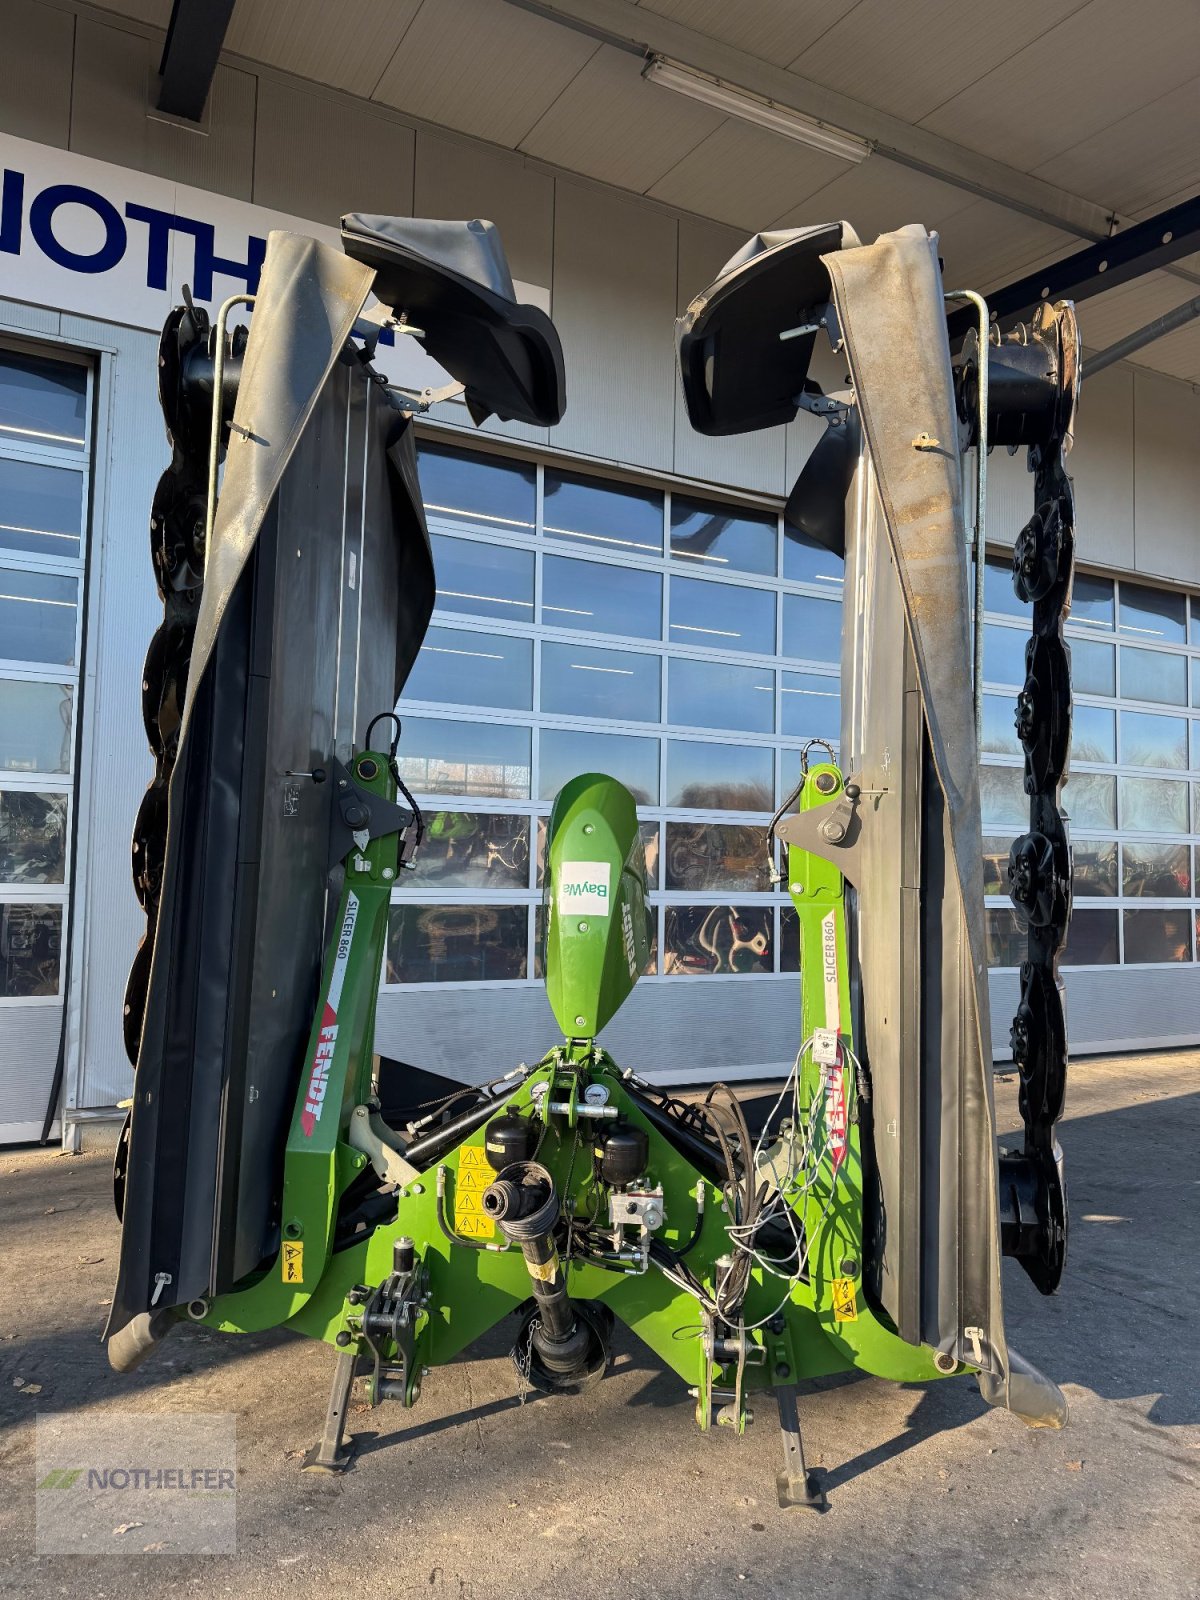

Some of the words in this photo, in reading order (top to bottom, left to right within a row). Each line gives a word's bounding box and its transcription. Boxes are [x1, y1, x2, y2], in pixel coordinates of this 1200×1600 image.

[563, 881, 607, 897] BayWa
[341, 901, 357, 937] SLICER
[824, 921, 834, 942] 860
[337, 939, 350, 959] 860
[621, 902, 637, 978] FENDT
[825, 945, 836, 982] SLICER
[305, 1024, 339, 1121] FENDT
